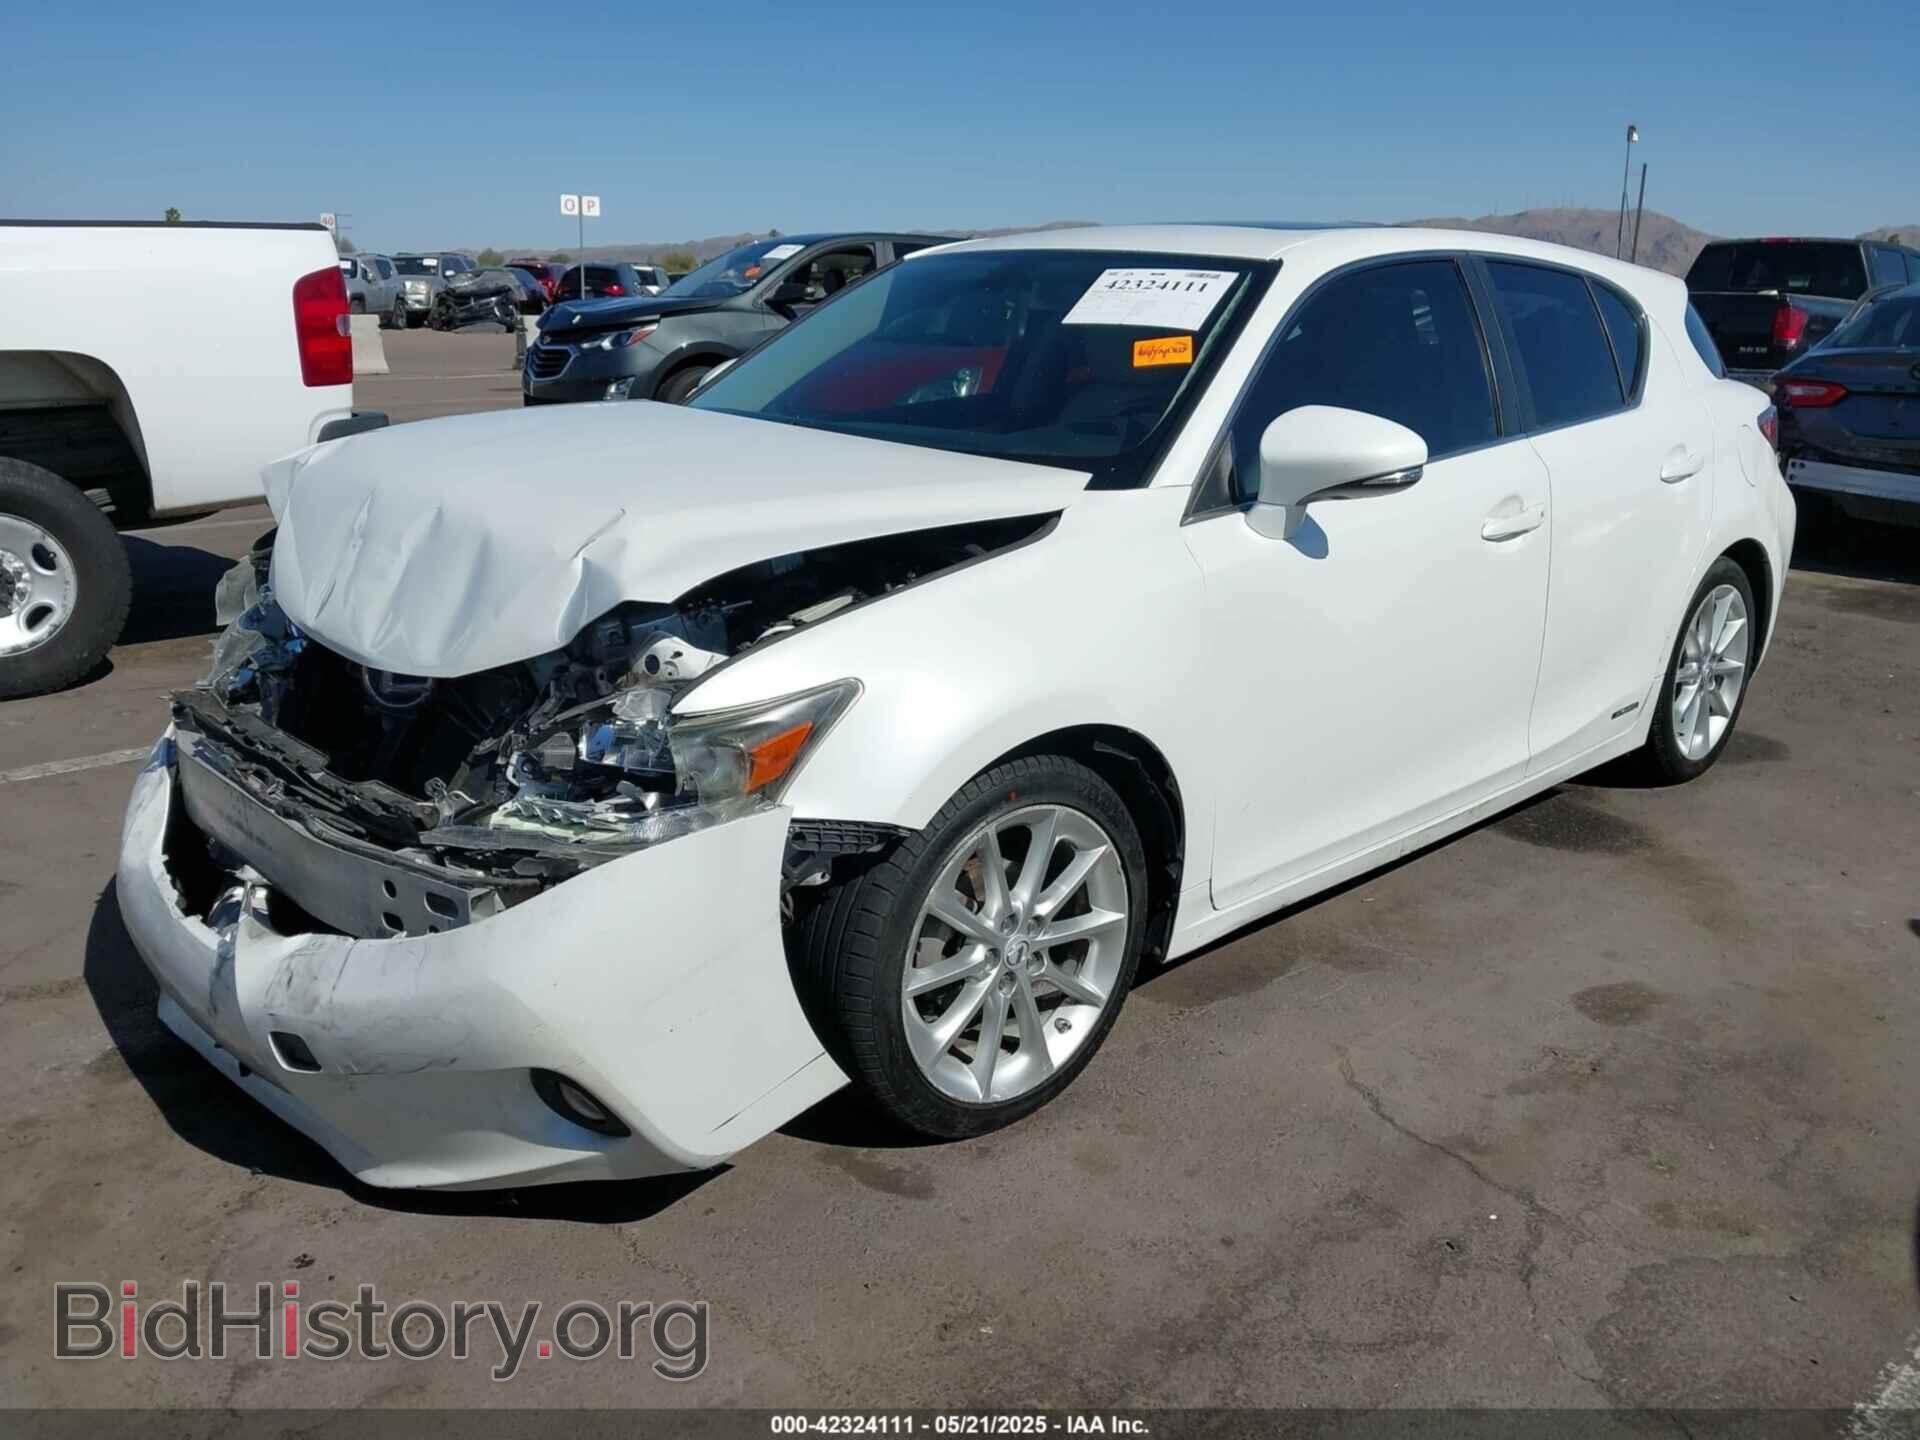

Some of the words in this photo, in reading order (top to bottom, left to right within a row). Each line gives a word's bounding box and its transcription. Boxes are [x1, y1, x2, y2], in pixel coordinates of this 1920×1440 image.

[564, 198, 576, 212] O
[586, 199, 596, 213] P
[1104, 279, 1208, 292] 42324111
